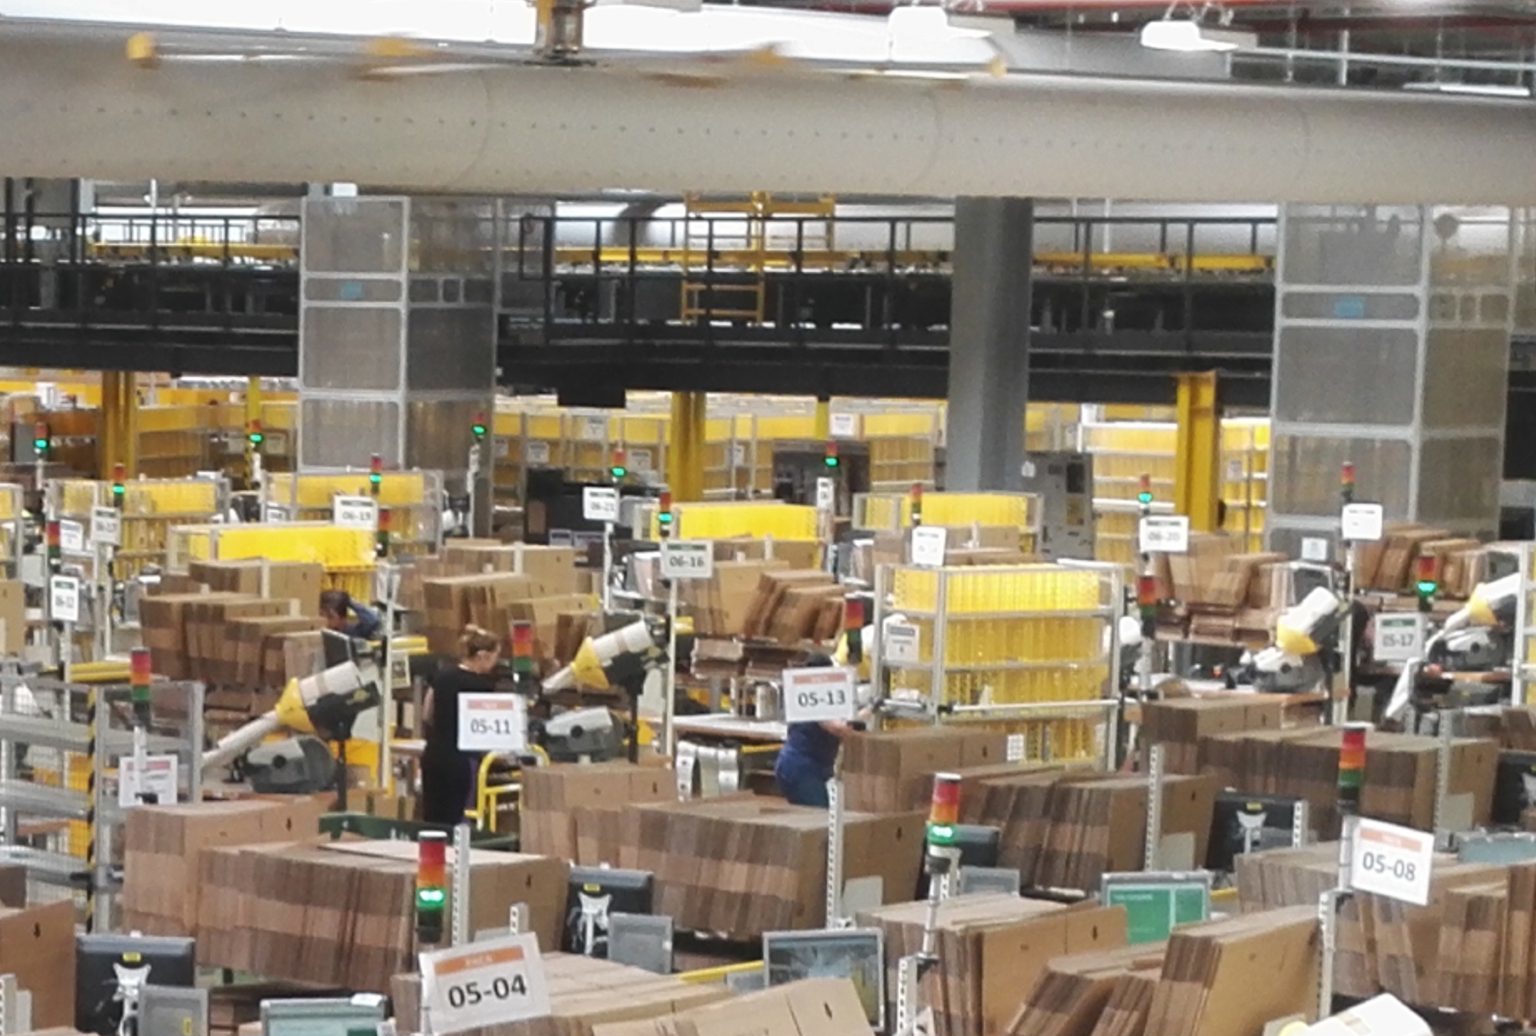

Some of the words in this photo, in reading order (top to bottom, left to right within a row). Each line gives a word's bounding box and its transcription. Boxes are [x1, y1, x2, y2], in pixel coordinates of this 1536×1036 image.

[669, 555, 705, 568] 06-16
[798, 689, 846, 708] 05-13
[470, 718, 511, 735] 05-11
[1363, 852, 1416, 882] 05-08
[448, 973, 527, 1009] 05-04
